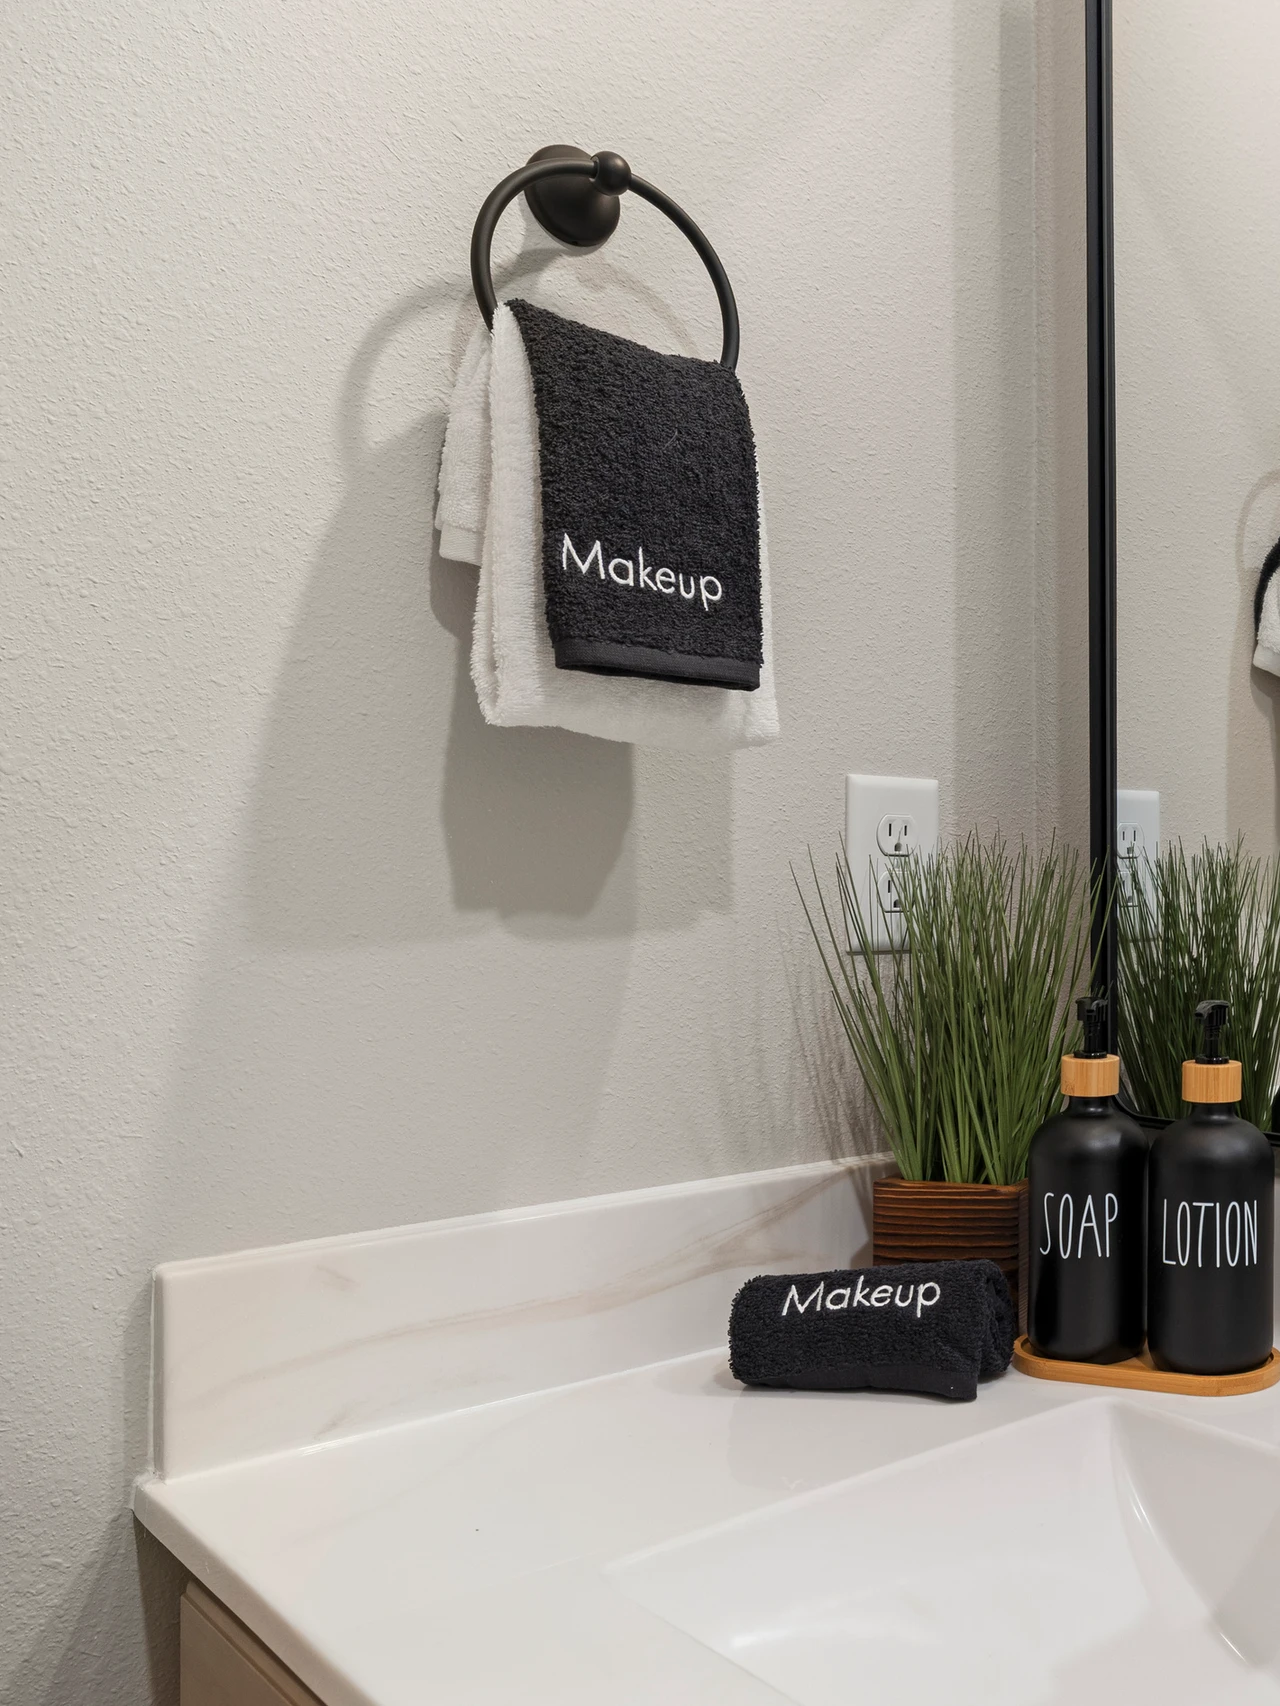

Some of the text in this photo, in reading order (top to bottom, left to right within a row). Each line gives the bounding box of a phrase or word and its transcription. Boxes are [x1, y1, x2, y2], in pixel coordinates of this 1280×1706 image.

[561, 532, 723, 611] Makeup
[1039, 1192, 1119, 1260] SOAP
[1162, 1198, 1258, 1268] LOTION
[781, 1275, 941, 1318] Makeup
